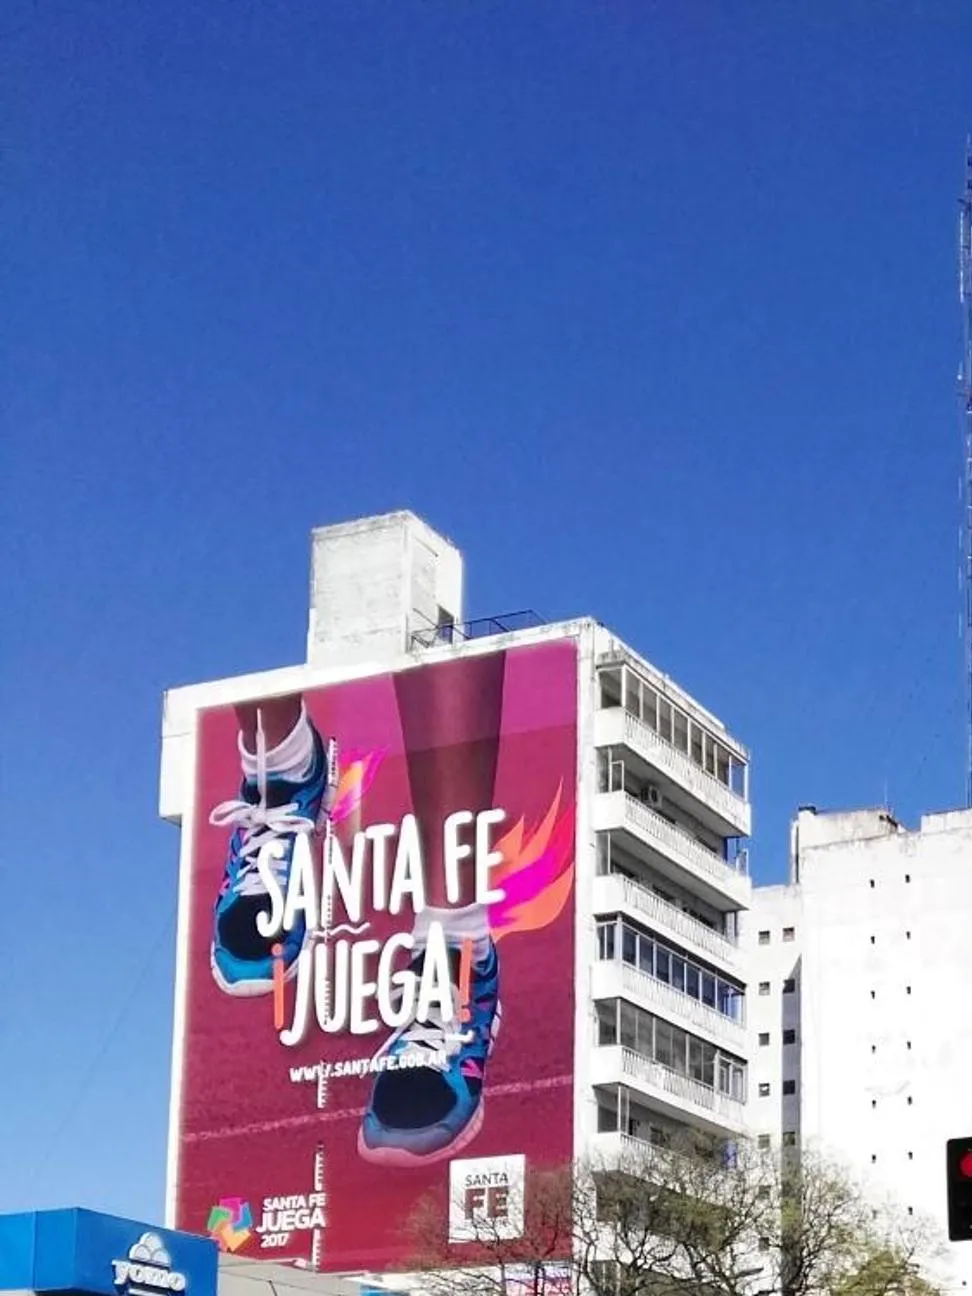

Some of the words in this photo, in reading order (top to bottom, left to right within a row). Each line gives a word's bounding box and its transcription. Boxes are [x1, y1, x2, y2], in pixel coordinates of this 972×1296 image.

[256, 813, 425, 938] SANTA
[443, 808, 507, 905] FE
[465, 1172, 508, 1187] SANTA
[263, 1194, 307, 1211] SANTA
[309, 1192, 327, 1207] FE
[464, 1186, 509, 1220] FE
[255, 1207, 326, 1233] JUEGA
[260, 1233, 290, 1248] 2017
